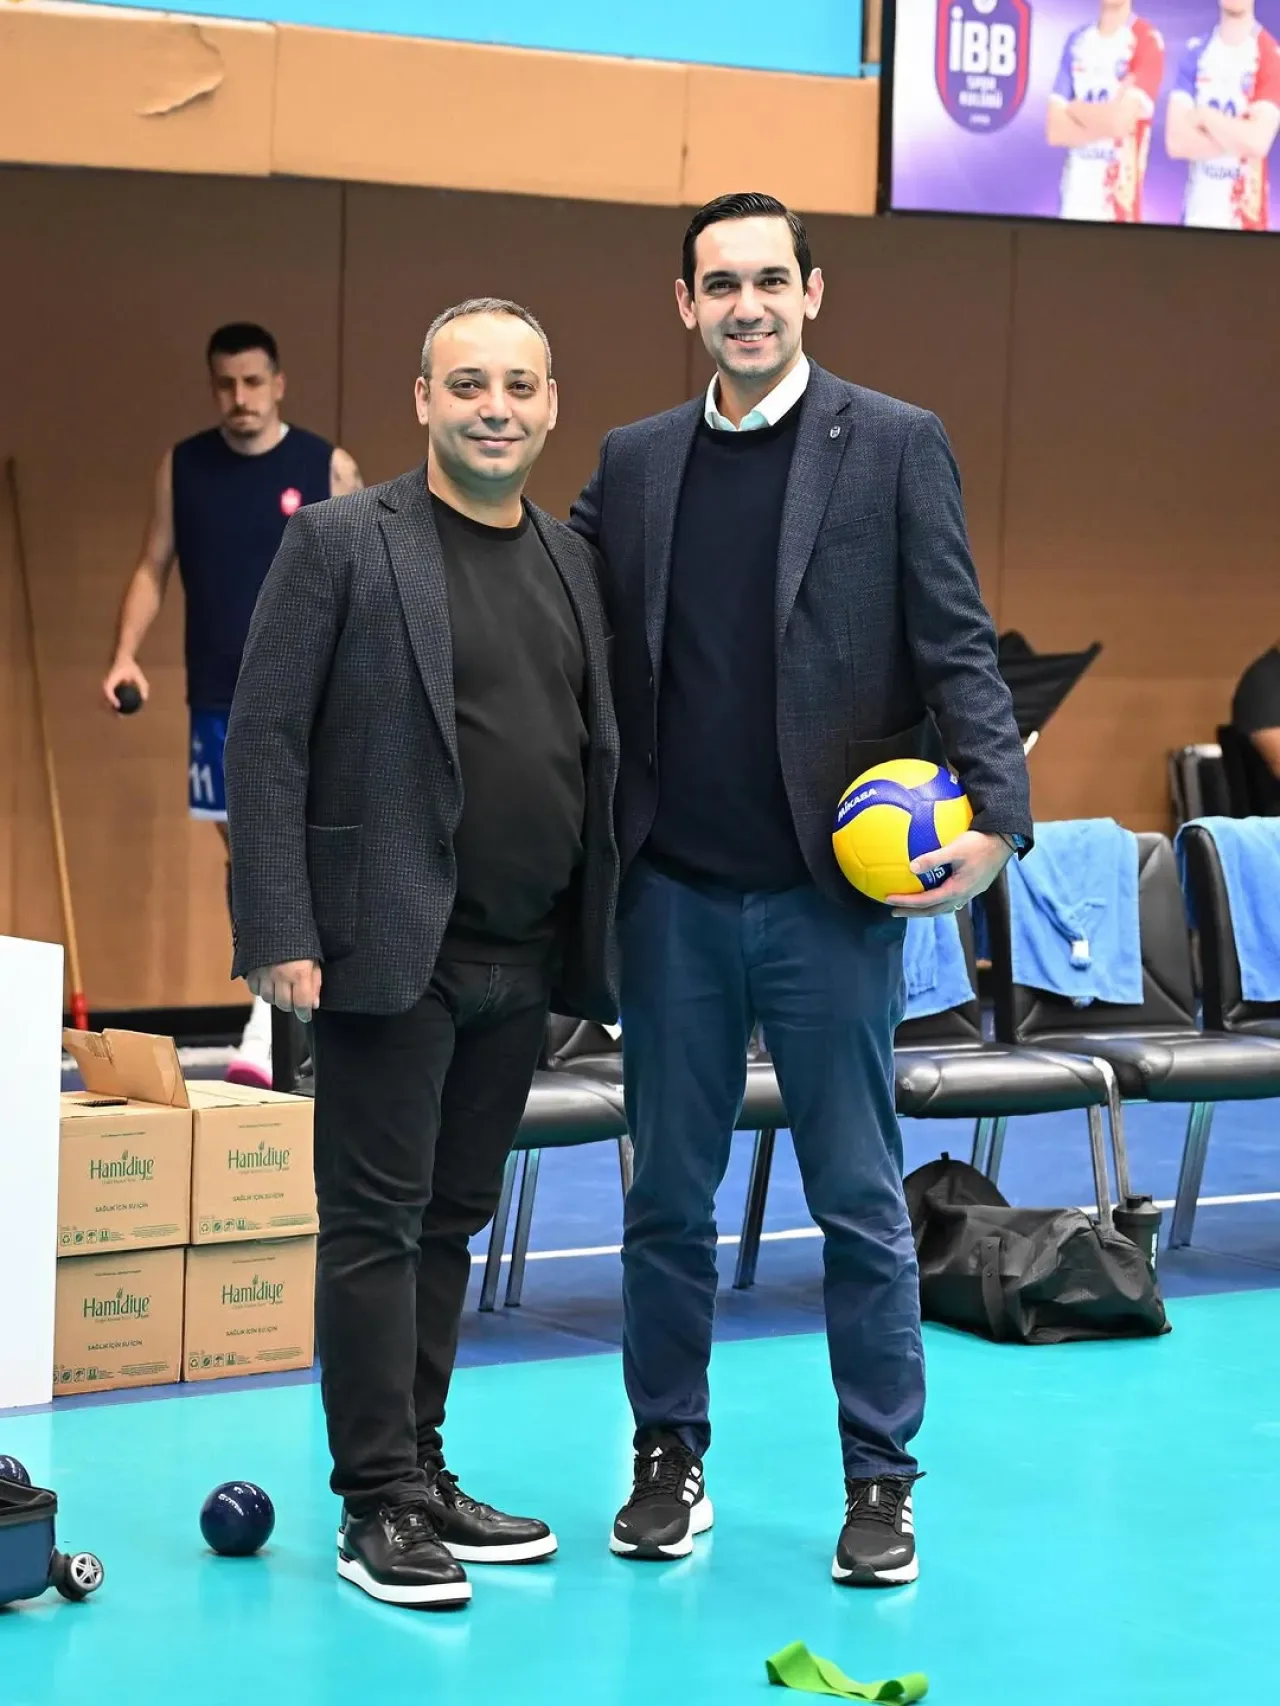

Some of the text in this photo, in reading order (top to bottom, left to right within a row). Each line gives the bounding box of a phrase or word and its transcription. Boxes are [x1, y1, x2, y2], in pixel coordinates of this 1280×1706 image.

[90, 1155, 154, 1180] Hamidiye
[228, 1145, 290, 1171] Hamidiye
[222, 1280, 284, 1304] Hamidiye
[83, 1294, 149, 1319] Hamidiye
